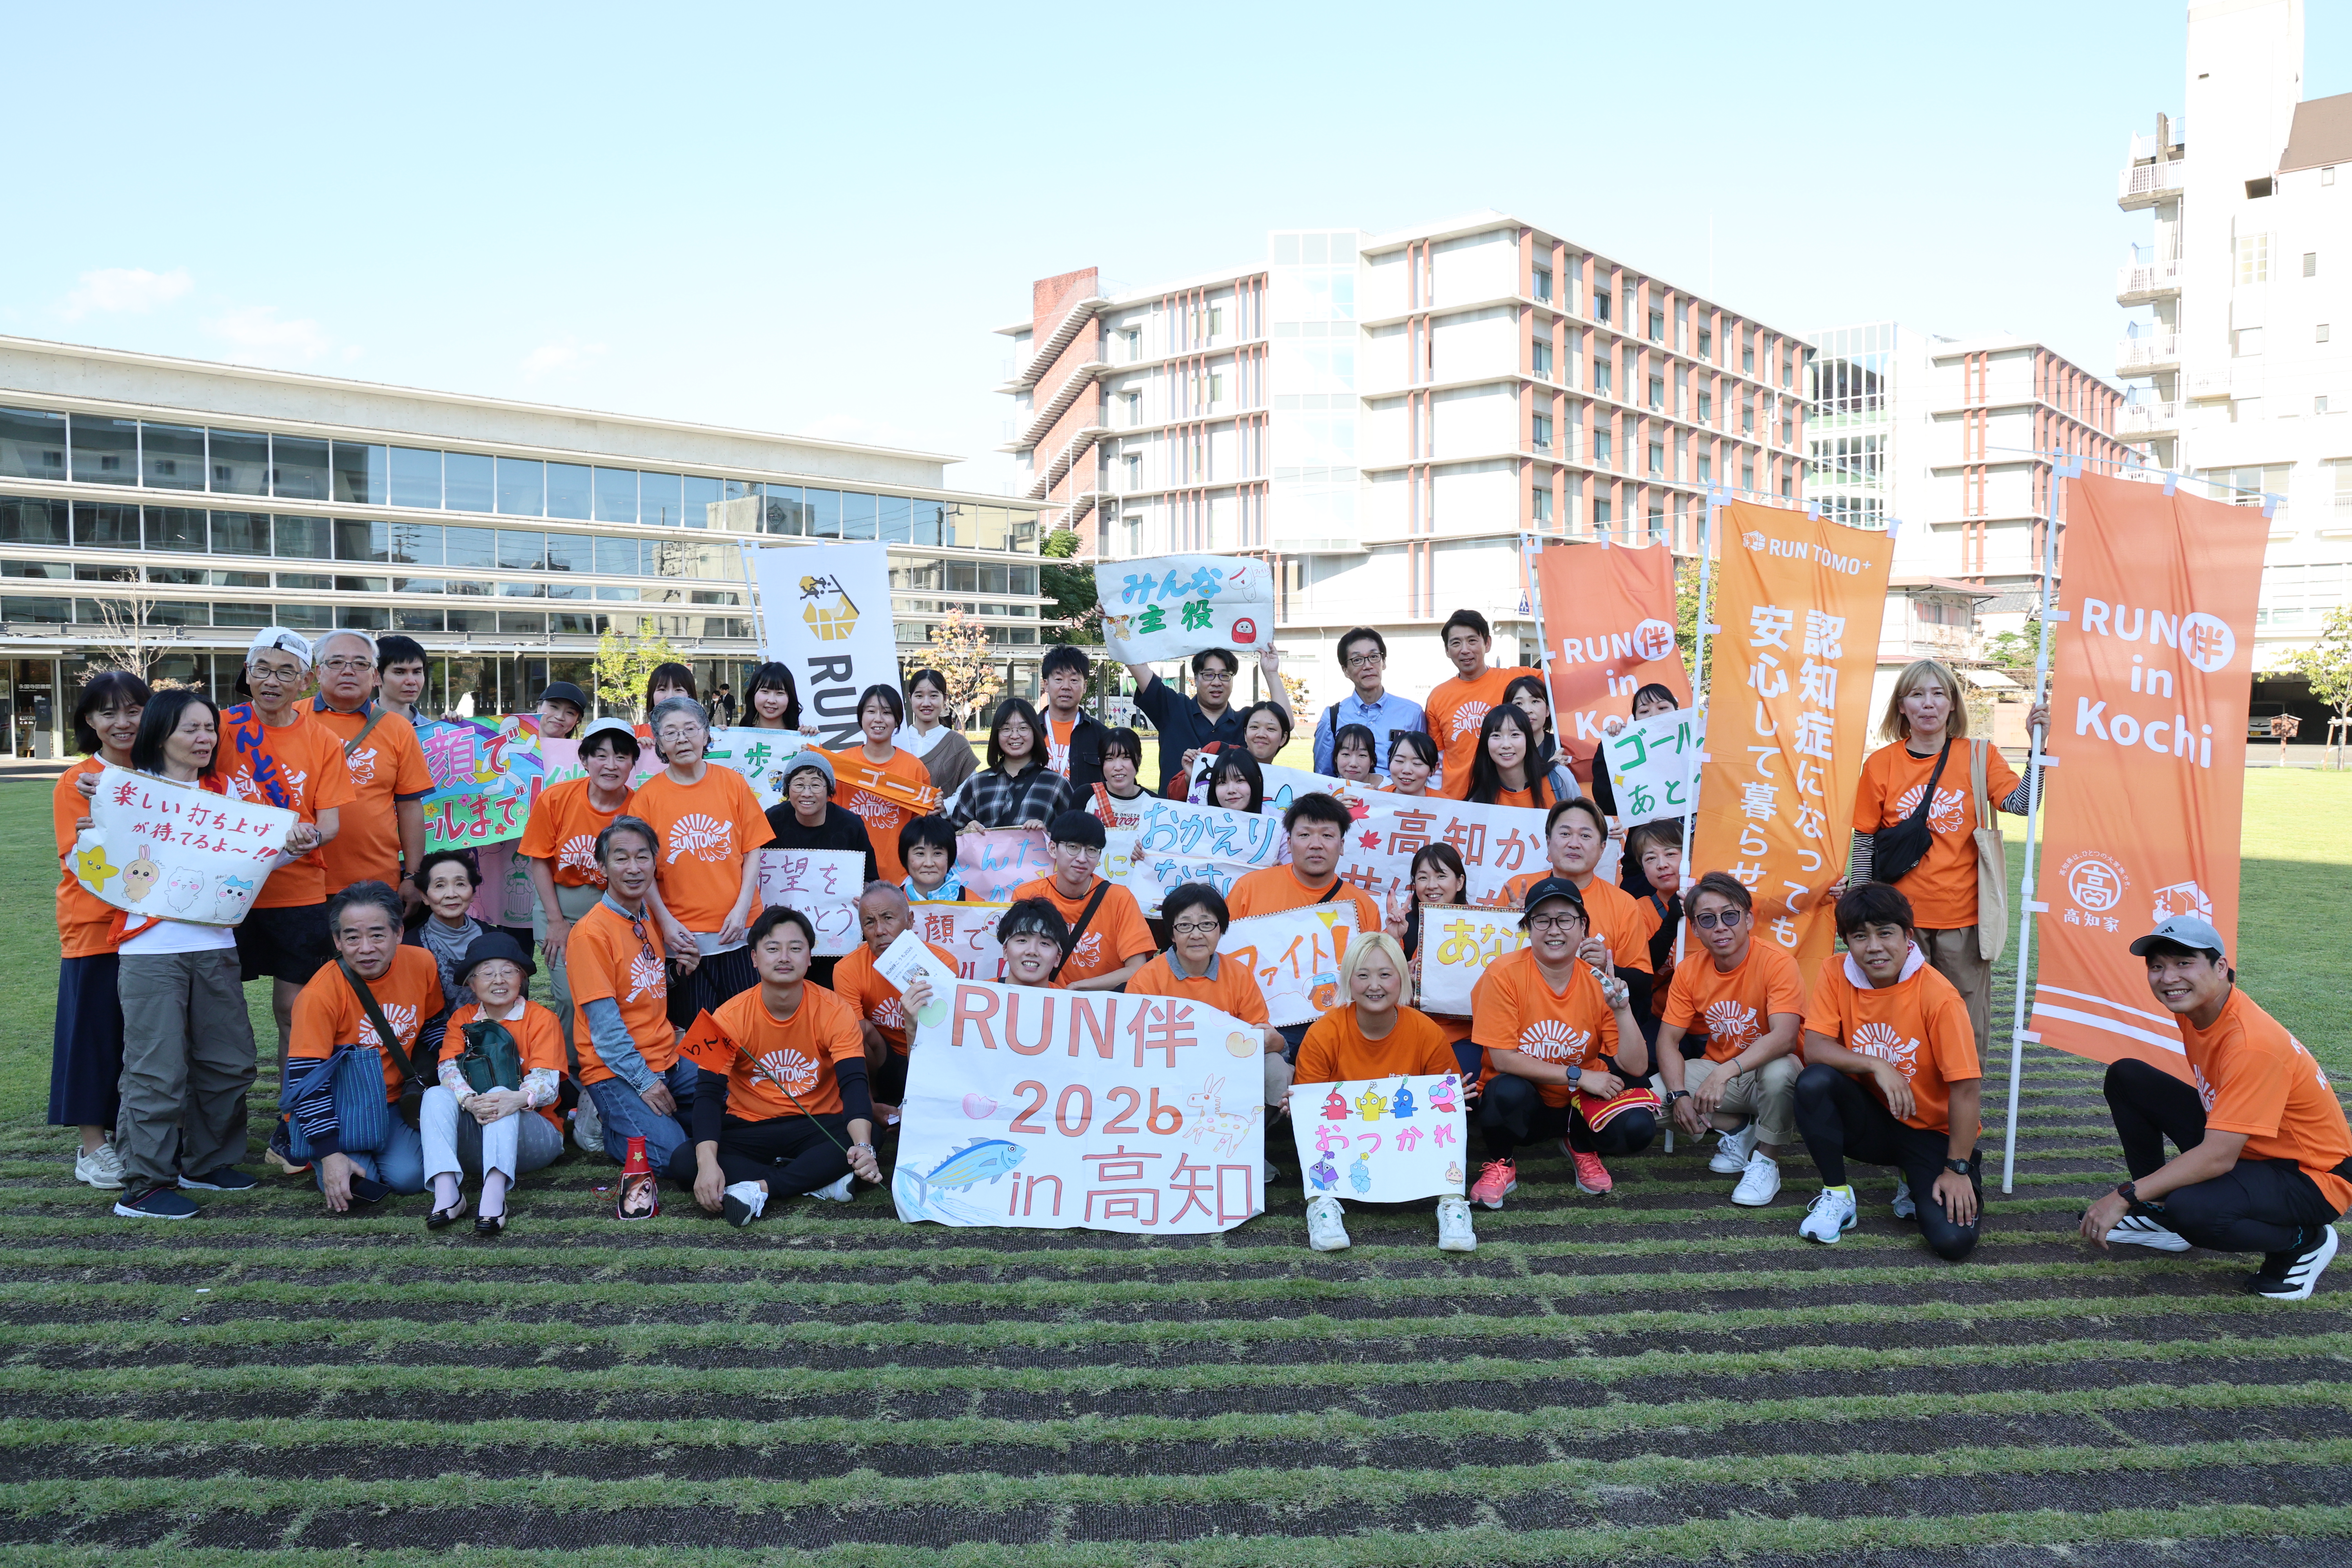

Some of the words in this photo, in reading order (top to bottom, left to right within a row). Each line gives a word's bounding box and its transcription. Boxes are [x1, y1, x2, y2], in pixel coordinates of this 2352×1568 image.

[1769, 539, 1808, 559] RUN
[1122, 567, 1222, 604] みんな
[1138, 600, 1213, 632] 主役
[2082, 597, 2225, 666] RUN伴
[1563, 625, 1669, 663] RUN伴
[1606, 670, 1639, 697] in
[2131, 654, 2172, 699] in
[808, 655, 865, 750] RUN
[1614, 722, 1704, 771] ゴール
[2076, 697, 2212, 768] Kochi
[858, 768, 934, 804] ゴール
[1628, 773, 1700, 815] あと
[1770, 609, 1846, 947] 認知症になっても
[1142, 802, 1276, 864] おかえり
[1387, 809, 1552, 871] 高知か
[560, 853, 598, 869] RUNTOM
[2064, 908, 2119, 933] 高知家
[1225, 926, 1349, 986] ファイト!
[952, 984, 1197, 1068] RUN伴
[1009, 1080, 1183, 1137] 2026
[1315, 1123, 1456, 1153] おつかれ
[1009, 1172, 1063, 1216] in
[1082, 1145, 1253, 1226] 高知
